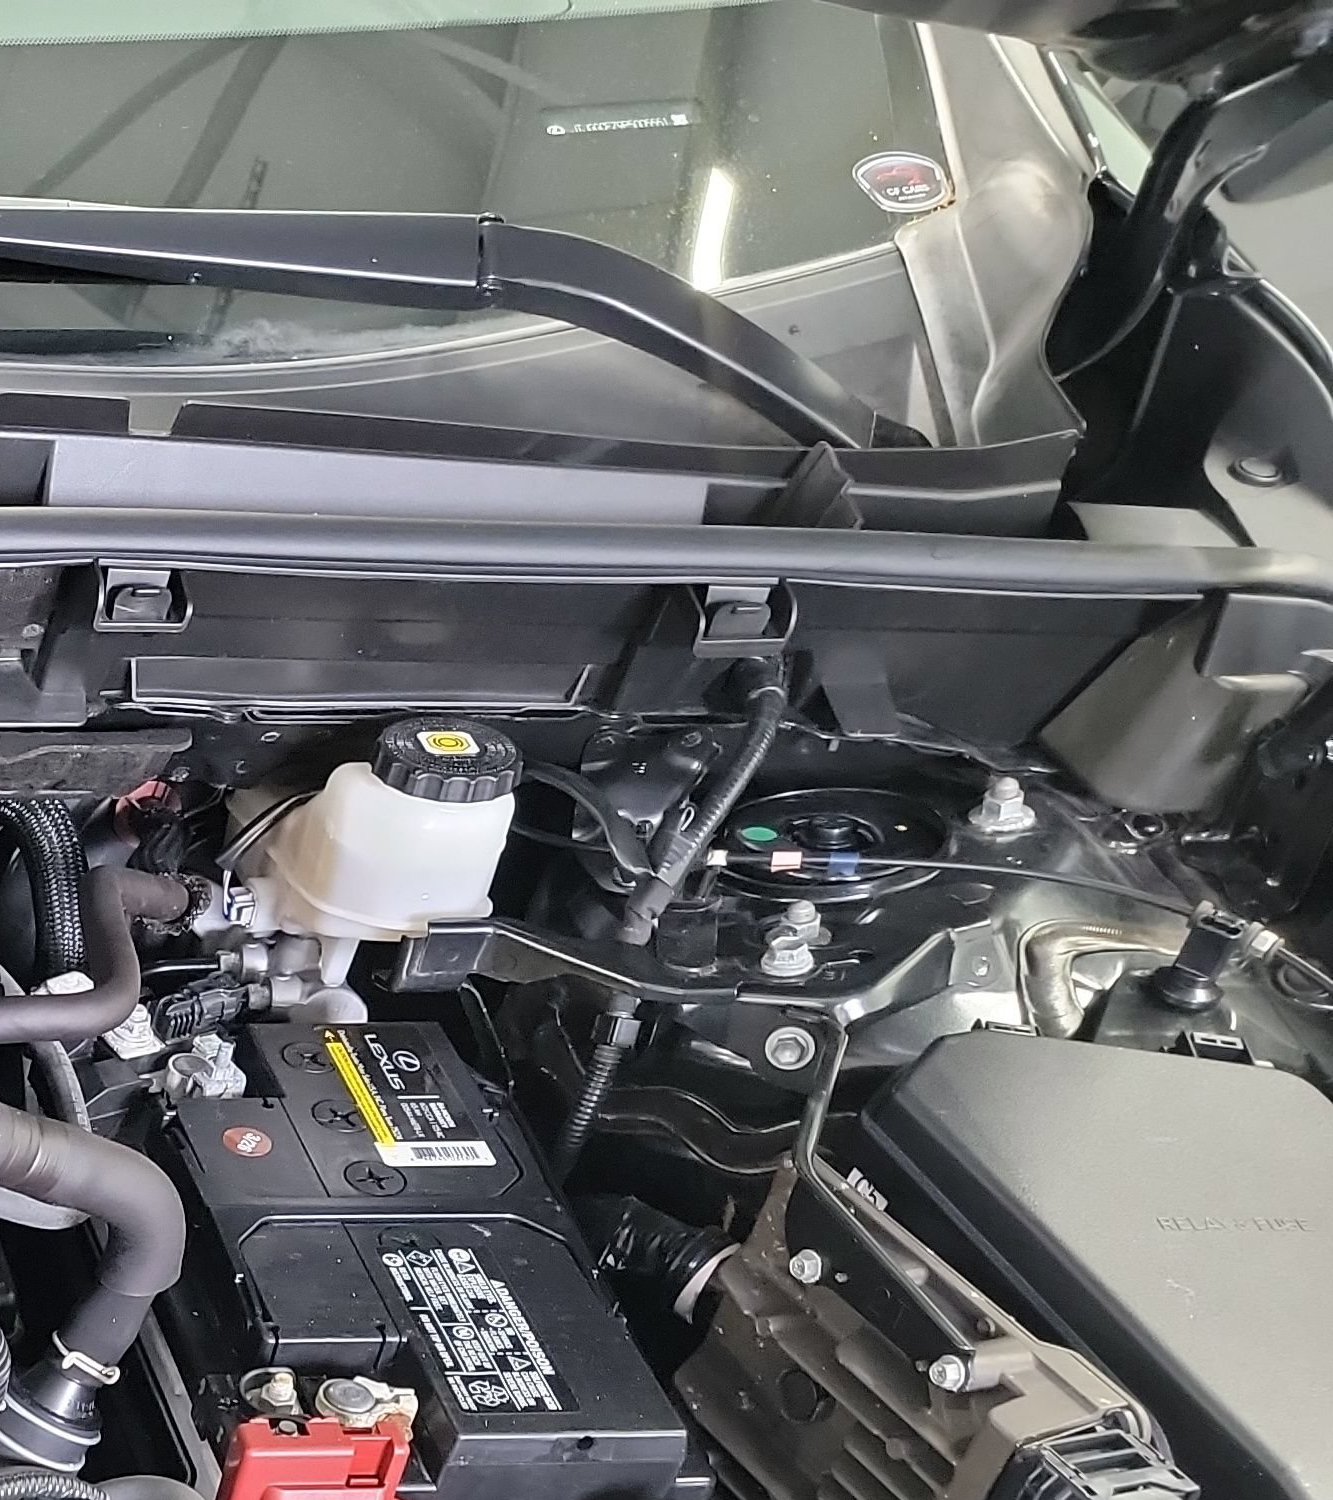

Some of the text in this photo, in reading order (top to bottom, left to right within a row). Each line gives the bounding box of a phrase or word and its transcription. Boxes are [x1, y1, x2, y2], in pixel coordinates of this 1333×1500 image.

[364, 1034, 406, 1090] LEXUS
[1156, 1216, 1230, 1232] RELA
[494, 1287, 555, 1374] DANGER/POISON
